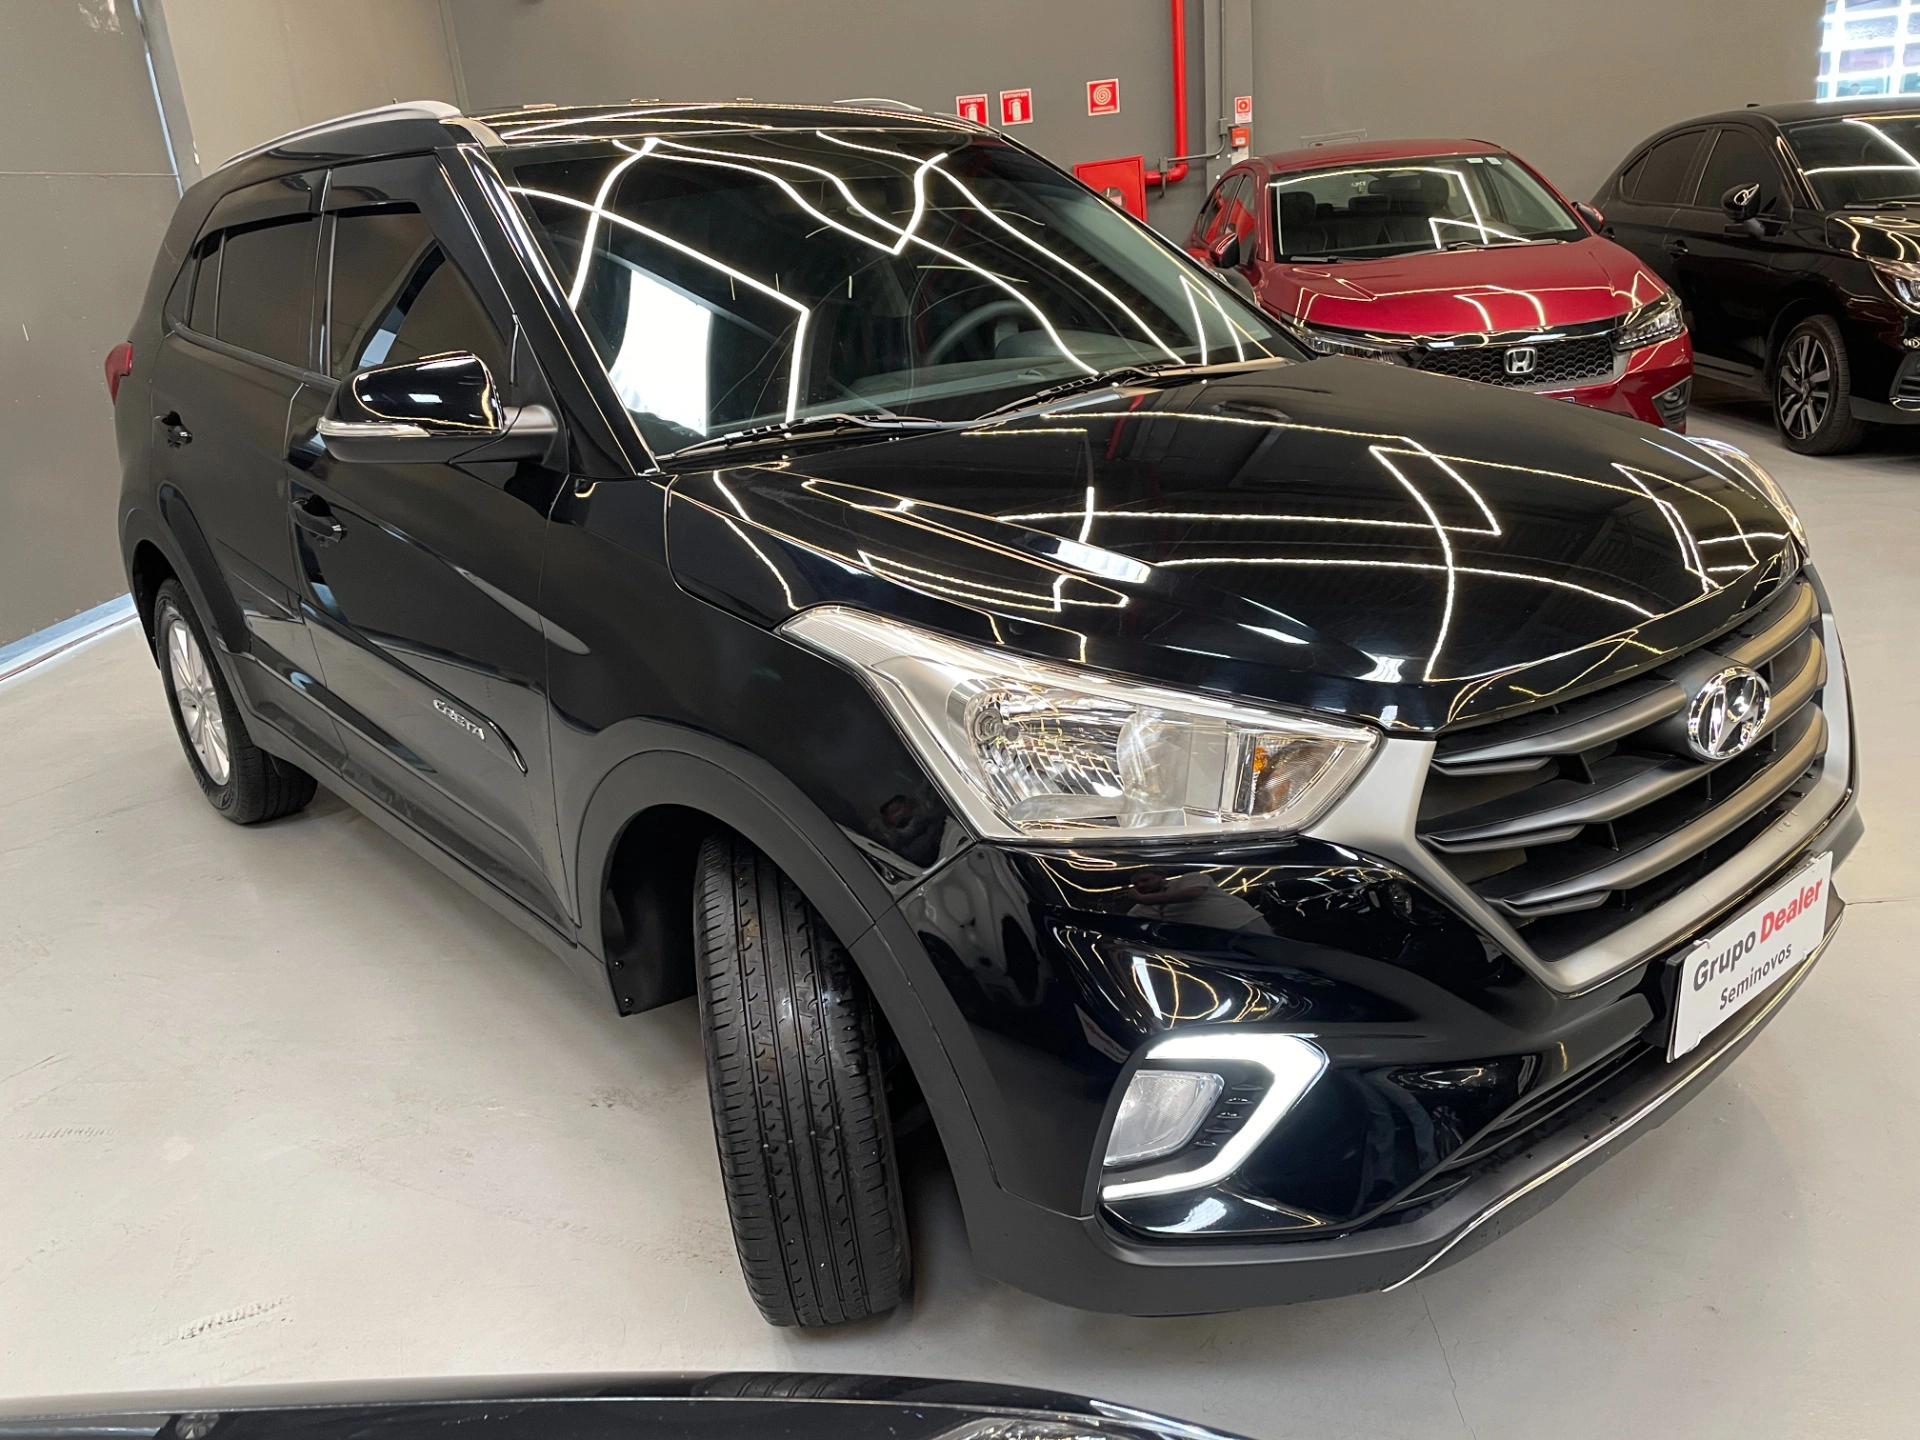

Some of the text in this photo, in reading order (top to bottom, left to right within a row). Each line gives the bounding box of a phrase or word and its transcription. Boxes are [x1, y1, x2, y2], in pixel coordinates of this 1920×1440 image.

[433, 699, 485, 740] CRETA
[1693, 878, 1823, 992] Grupo Dealer
[1719, 943, 1792, 1011] Seminovos
